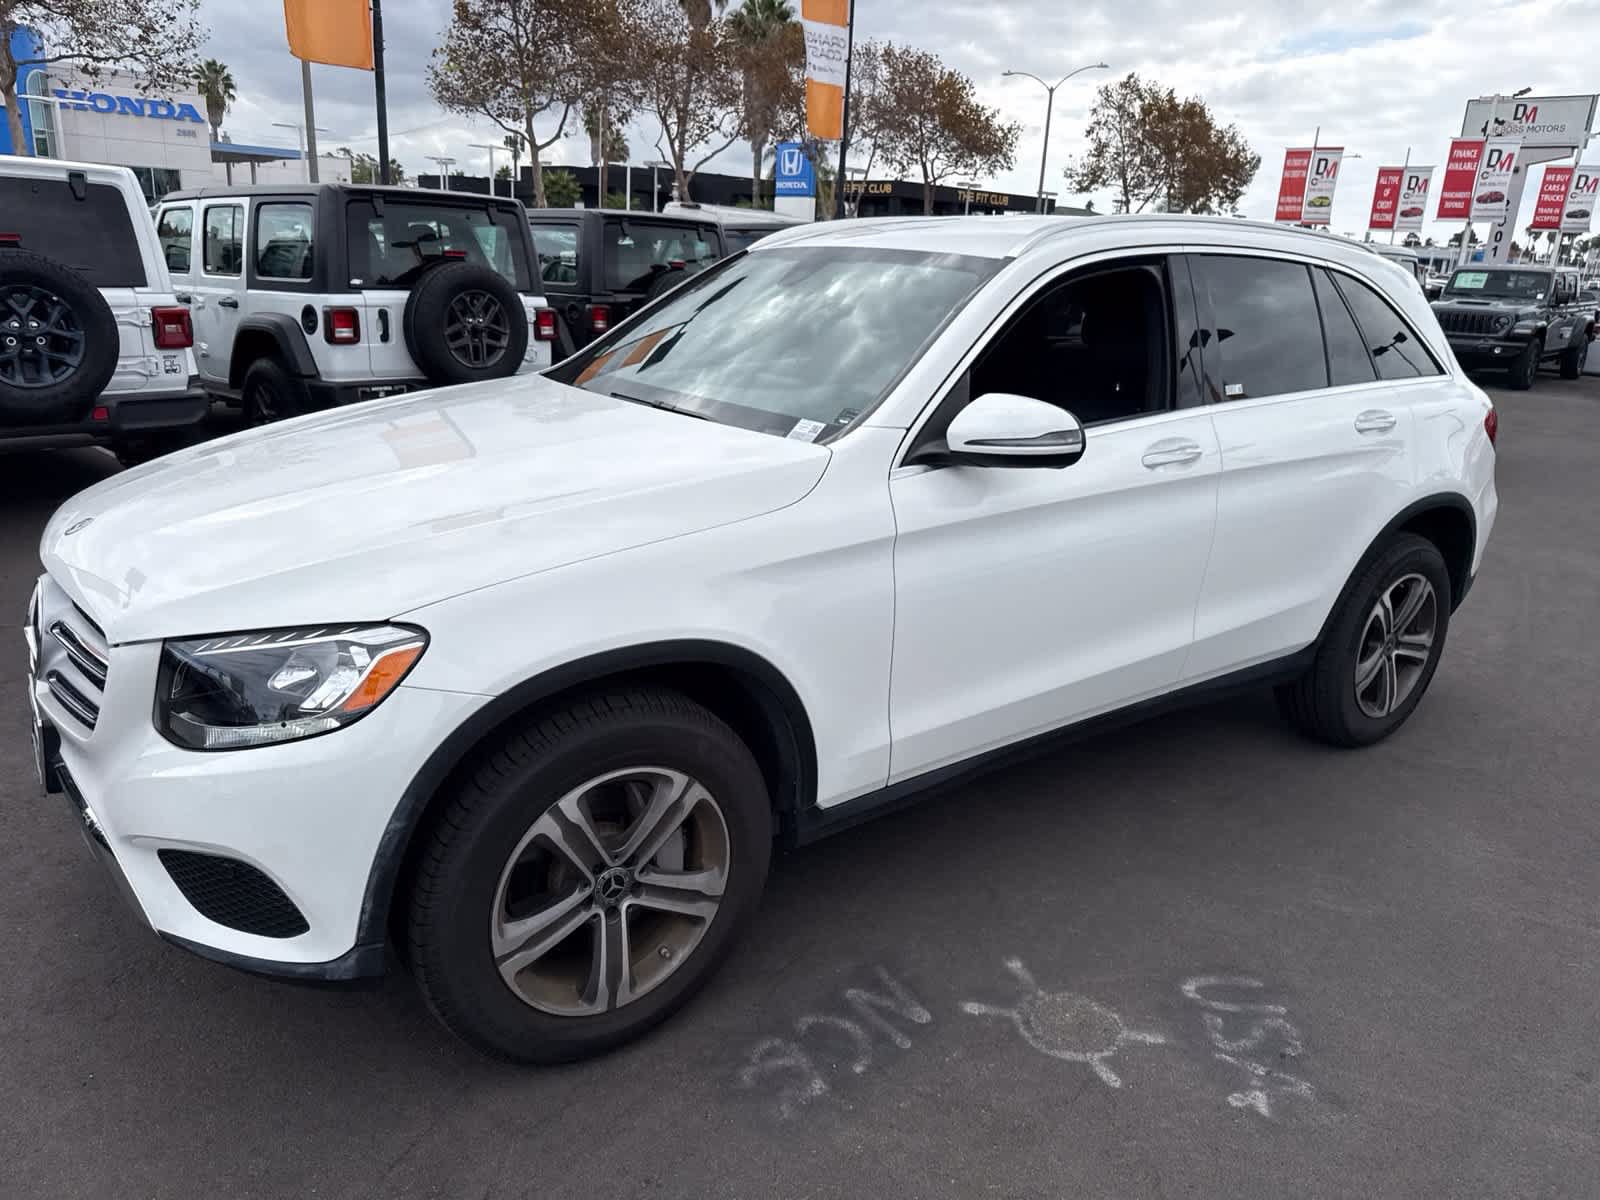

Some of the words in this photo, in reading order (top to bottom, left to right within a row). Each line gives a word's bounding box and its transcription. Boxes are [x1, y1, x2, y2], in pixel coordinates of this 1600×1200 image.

[52, 89, 205, 123] HONDA
[1526, 124, 1567, 134] MOTORS
[1453, 149, 1479, 158] FINANCE
[868, 184, 892, 193] CLUB
[957, 190, 975, 203] THE
[976, 191, 989, 204] FIT
[990, 194, 1009, 206] CLUB
